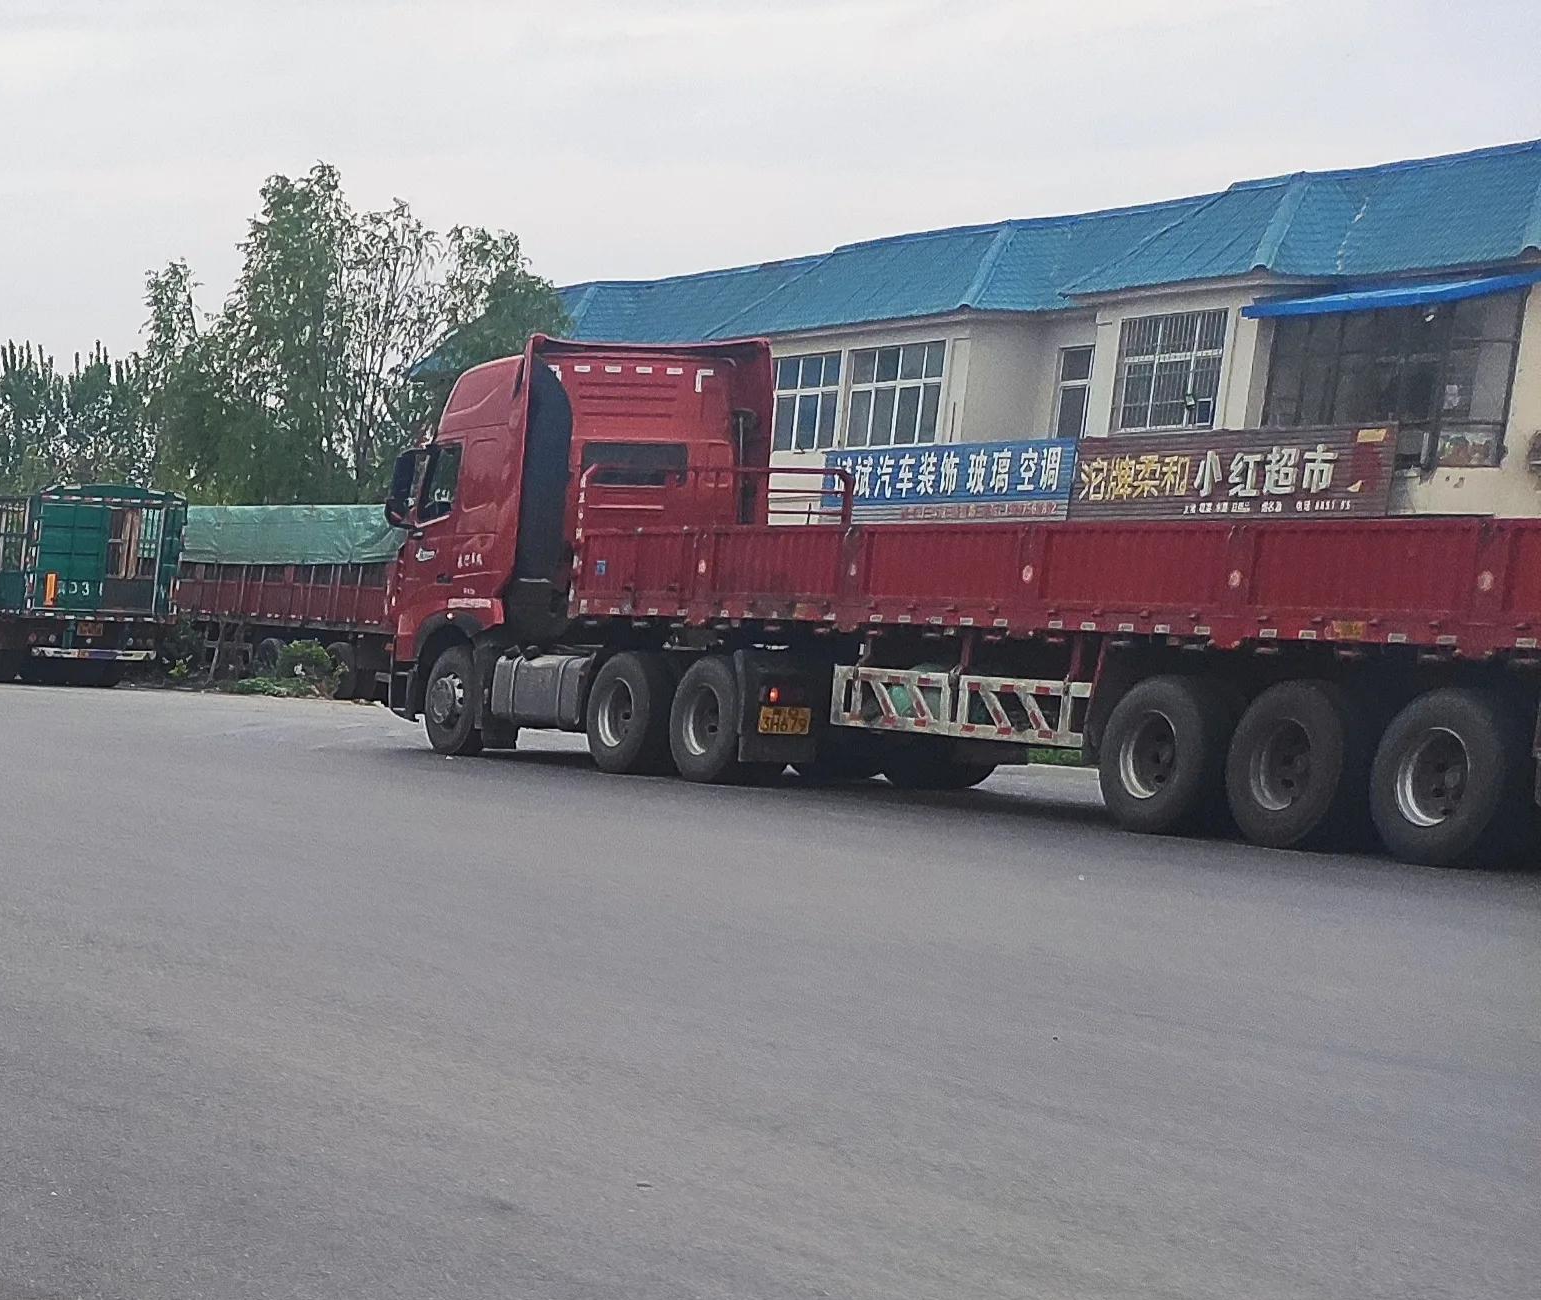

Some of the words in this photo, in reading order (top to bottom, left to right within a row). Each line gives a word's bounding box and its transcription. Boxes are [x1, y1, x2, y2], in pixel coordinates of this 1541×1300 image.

[967, 449, 1011, 495] 玻璃
[1017, 446, 1062, 493] 空调
[1193, 443, 1339, 498] 小红超市
